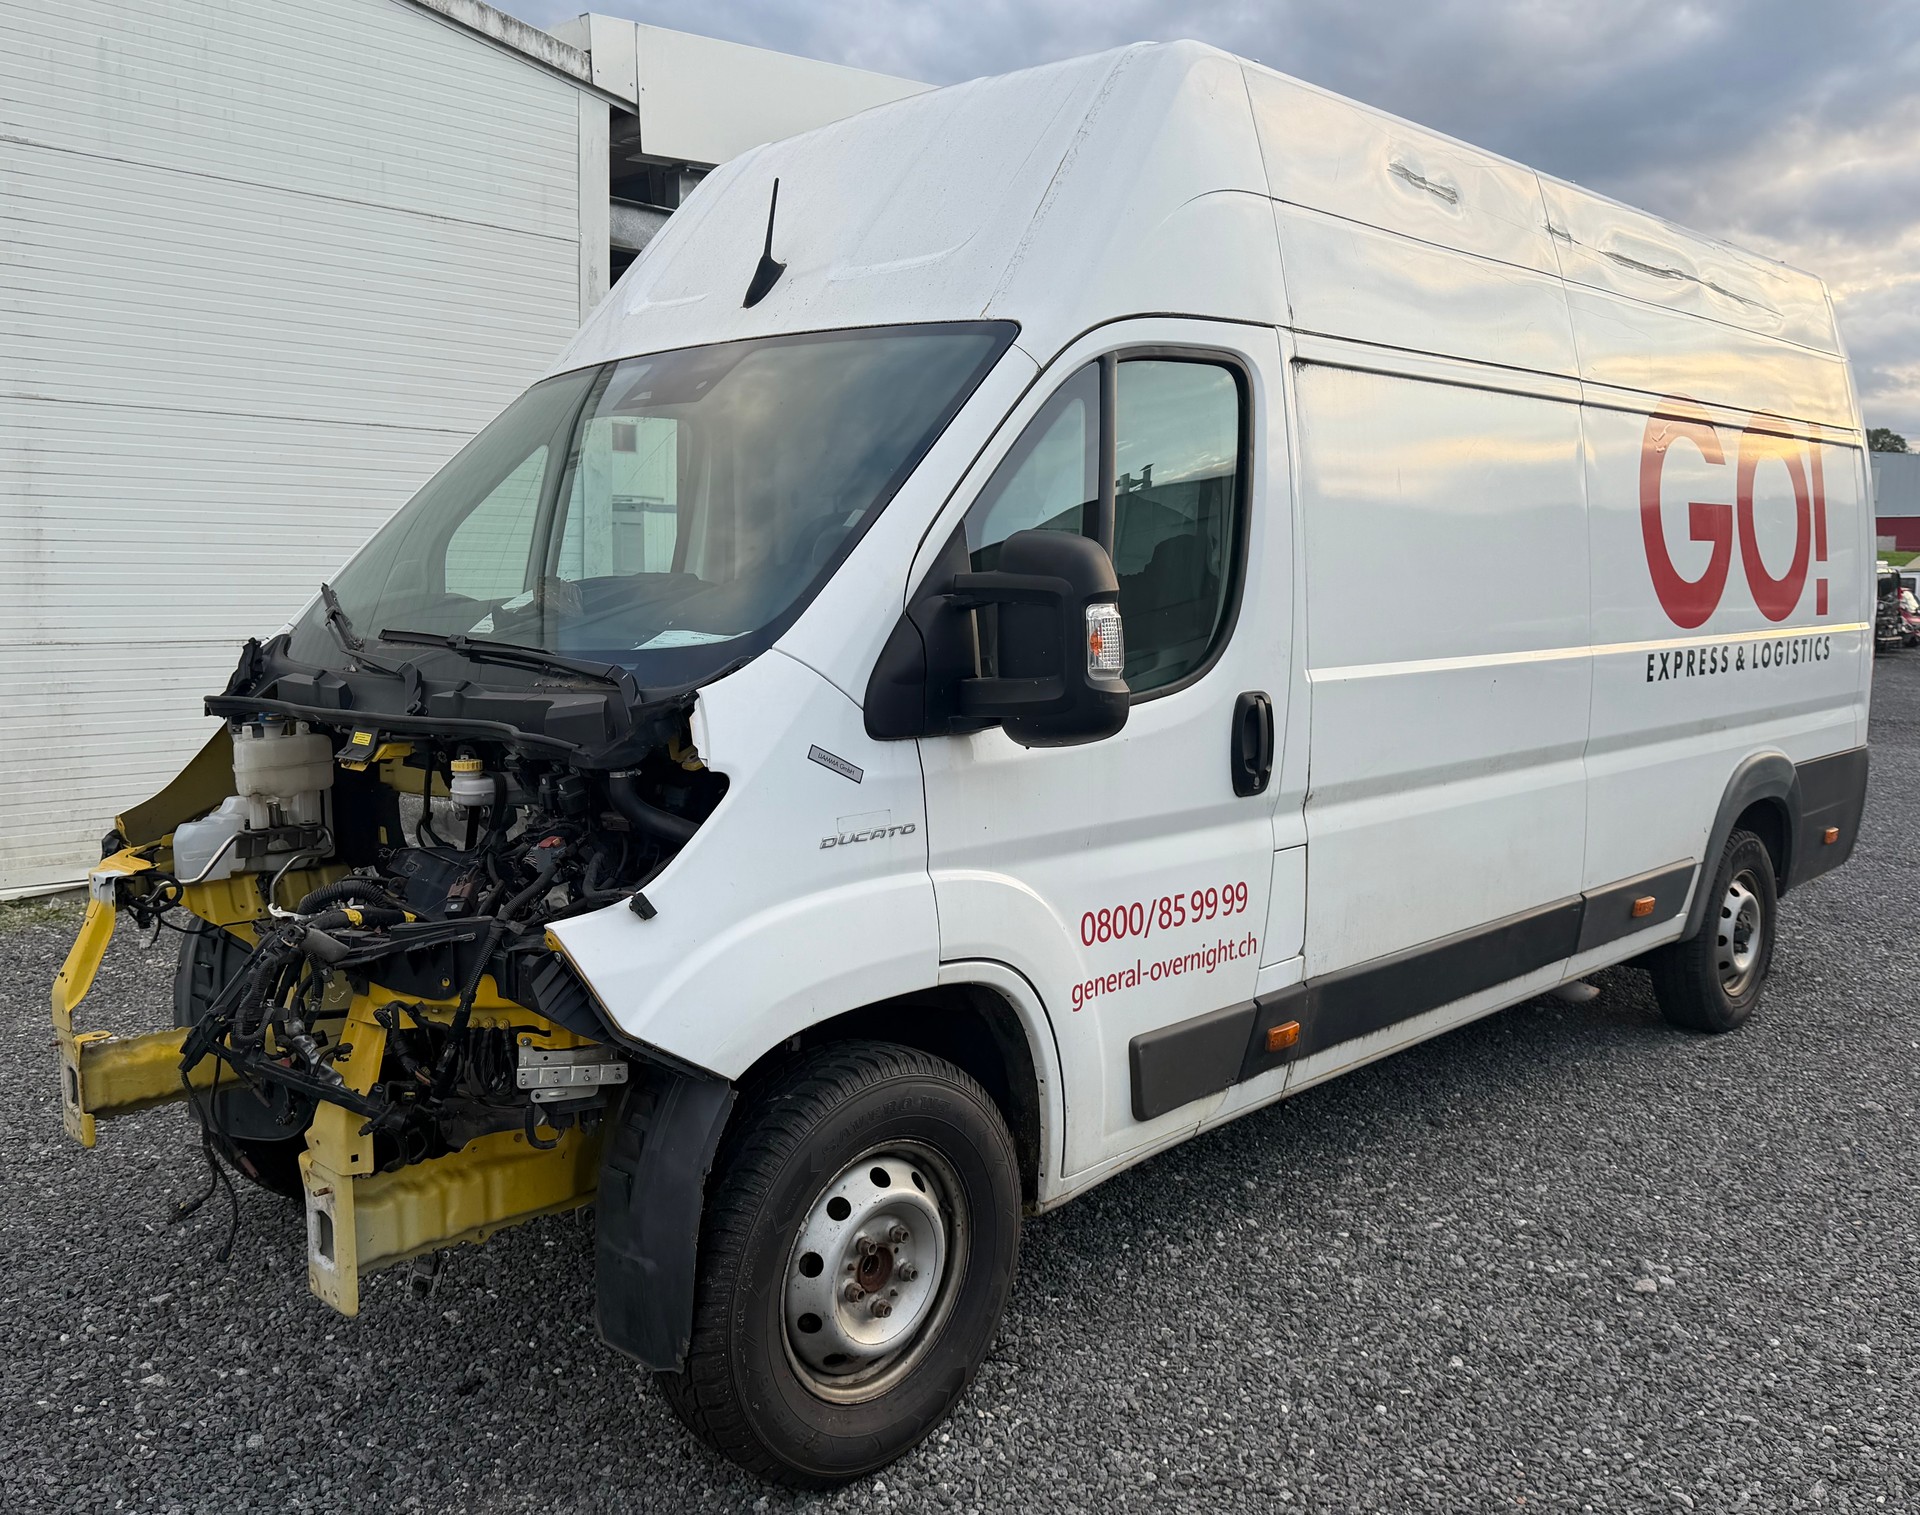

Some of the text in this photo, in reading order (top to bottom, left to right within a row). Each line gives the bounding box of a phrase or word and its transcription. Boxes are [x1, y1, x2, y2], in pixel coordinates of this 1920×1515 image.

[1639, 391, 1829, 629] GO!
[1646, 635, 1831, 682] EXPRESS & LOGISTICS
[820, 823, 917, 850] DUCATO
[1071, 931, 1257, 1012] general-overnight.ch
